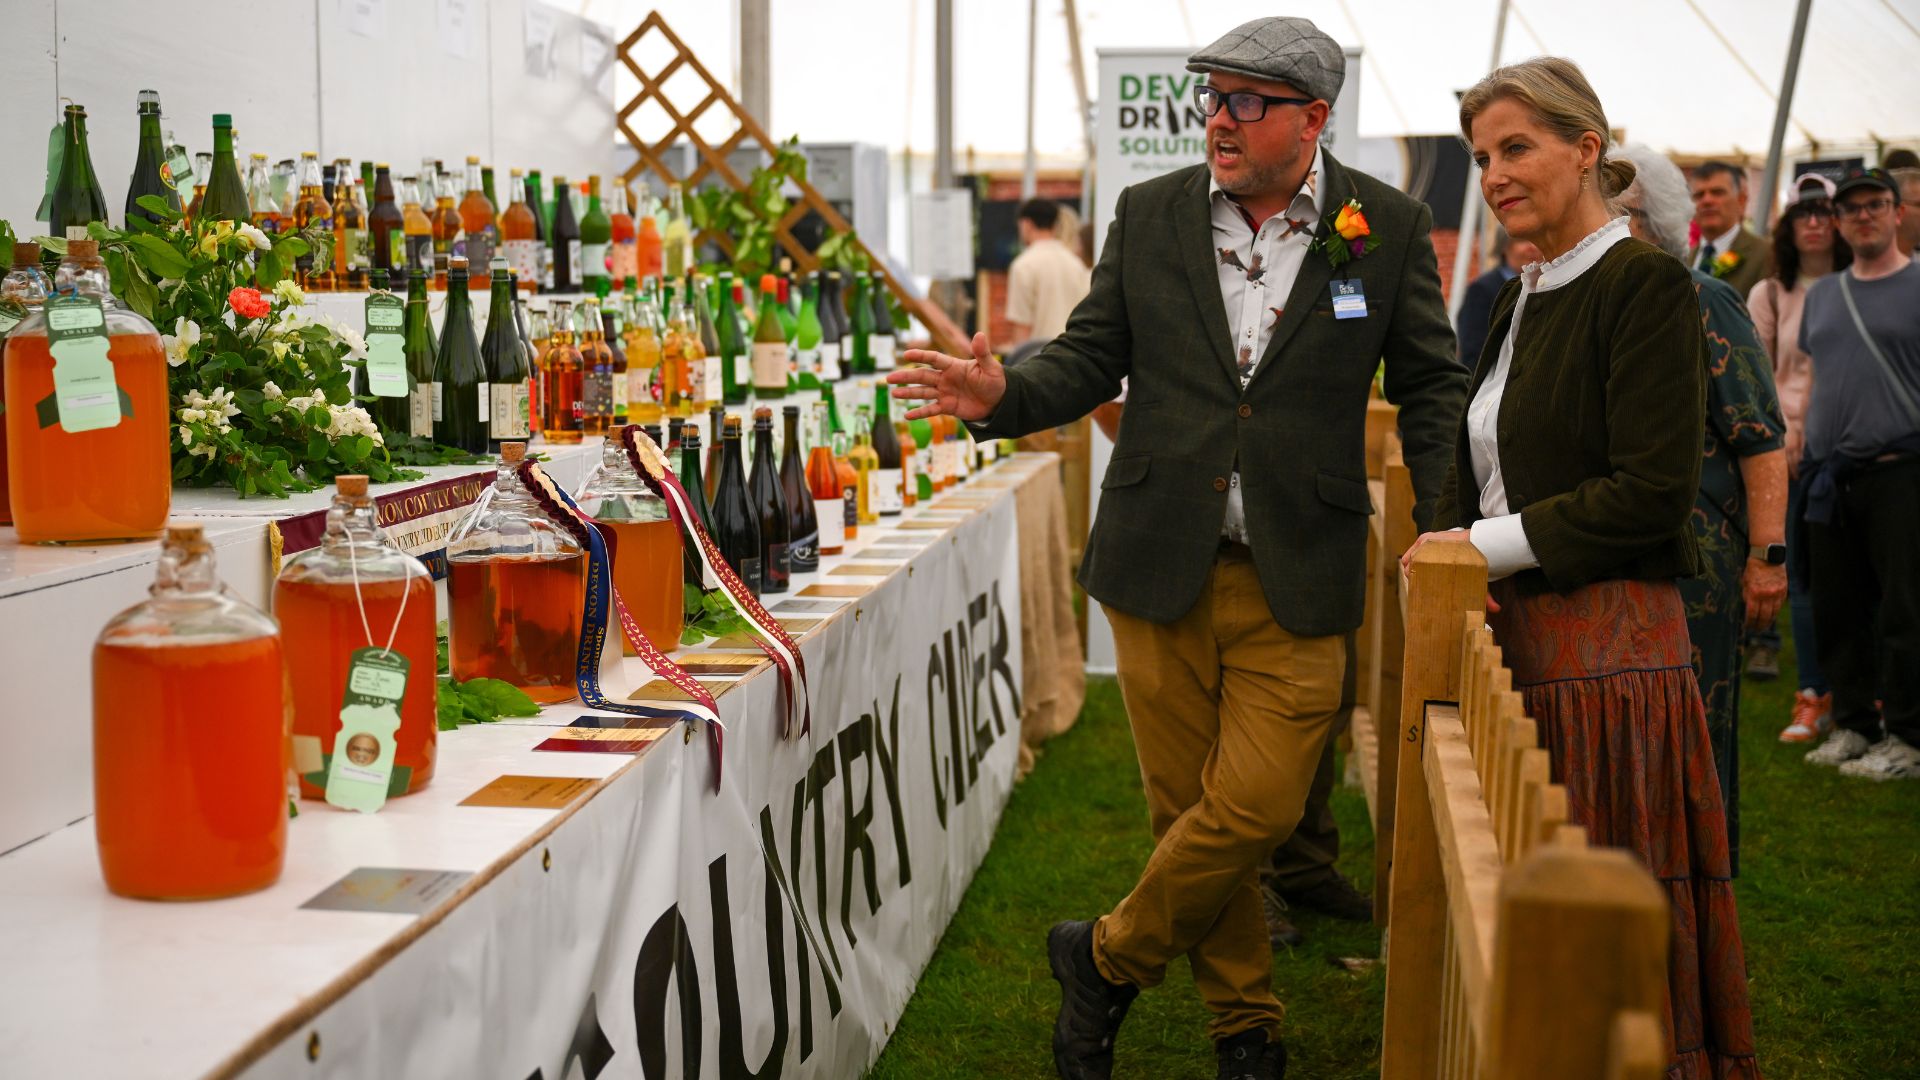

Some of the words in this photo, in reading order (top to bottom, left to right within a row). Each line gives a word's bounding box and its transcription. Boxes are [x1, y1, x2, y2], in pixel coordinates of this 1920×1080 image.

[1120, 75, 1204, 101] DEV
[1120, 101, 1206, 133] DRIN
[1120, 138, 1206, 155] SOLUTI
[377, 500, 404, 525] VON
[404, 487, 450, 517] COUNTY
[587, 561, 600, 618] DEVON
[702, 530, 726, 566] WEST
[724, 567, 773, 622] COUNTRY
[727, 581, 785, 642] CHAMPION
[580, 622, 595, 677] DRINK
[591, 625, 605, 695] Sponsored
[624, 612, 687, 676] COUNTRY
[665, 674, 702, 698] 2026
[927, 579, 1021, 831] CIDER
